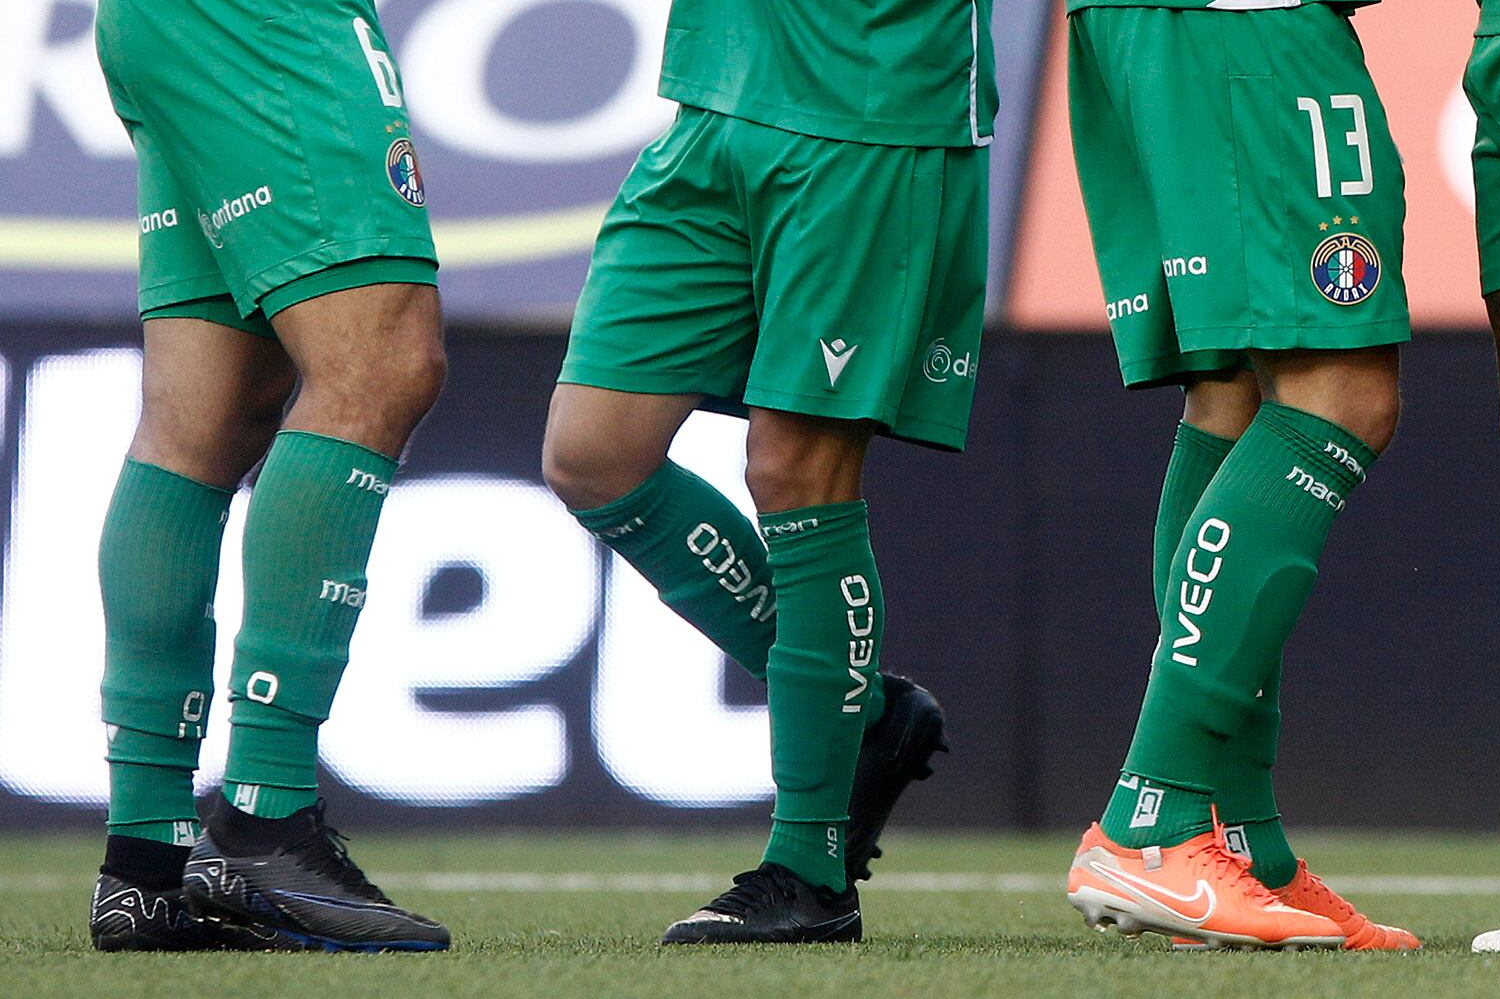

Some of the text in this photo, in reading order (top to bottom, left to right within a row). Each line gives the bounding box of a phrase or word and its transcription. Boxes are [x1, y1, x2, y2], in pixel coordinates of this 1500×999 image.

[352, 16, 402, 108] 6
[1296, 94, 1374, 199] 13
[1323, 282, 1369, 302] AUDAX
[839, 573, 874, 713] IVECO
[1172, 516, 1231, 667] IVECO
